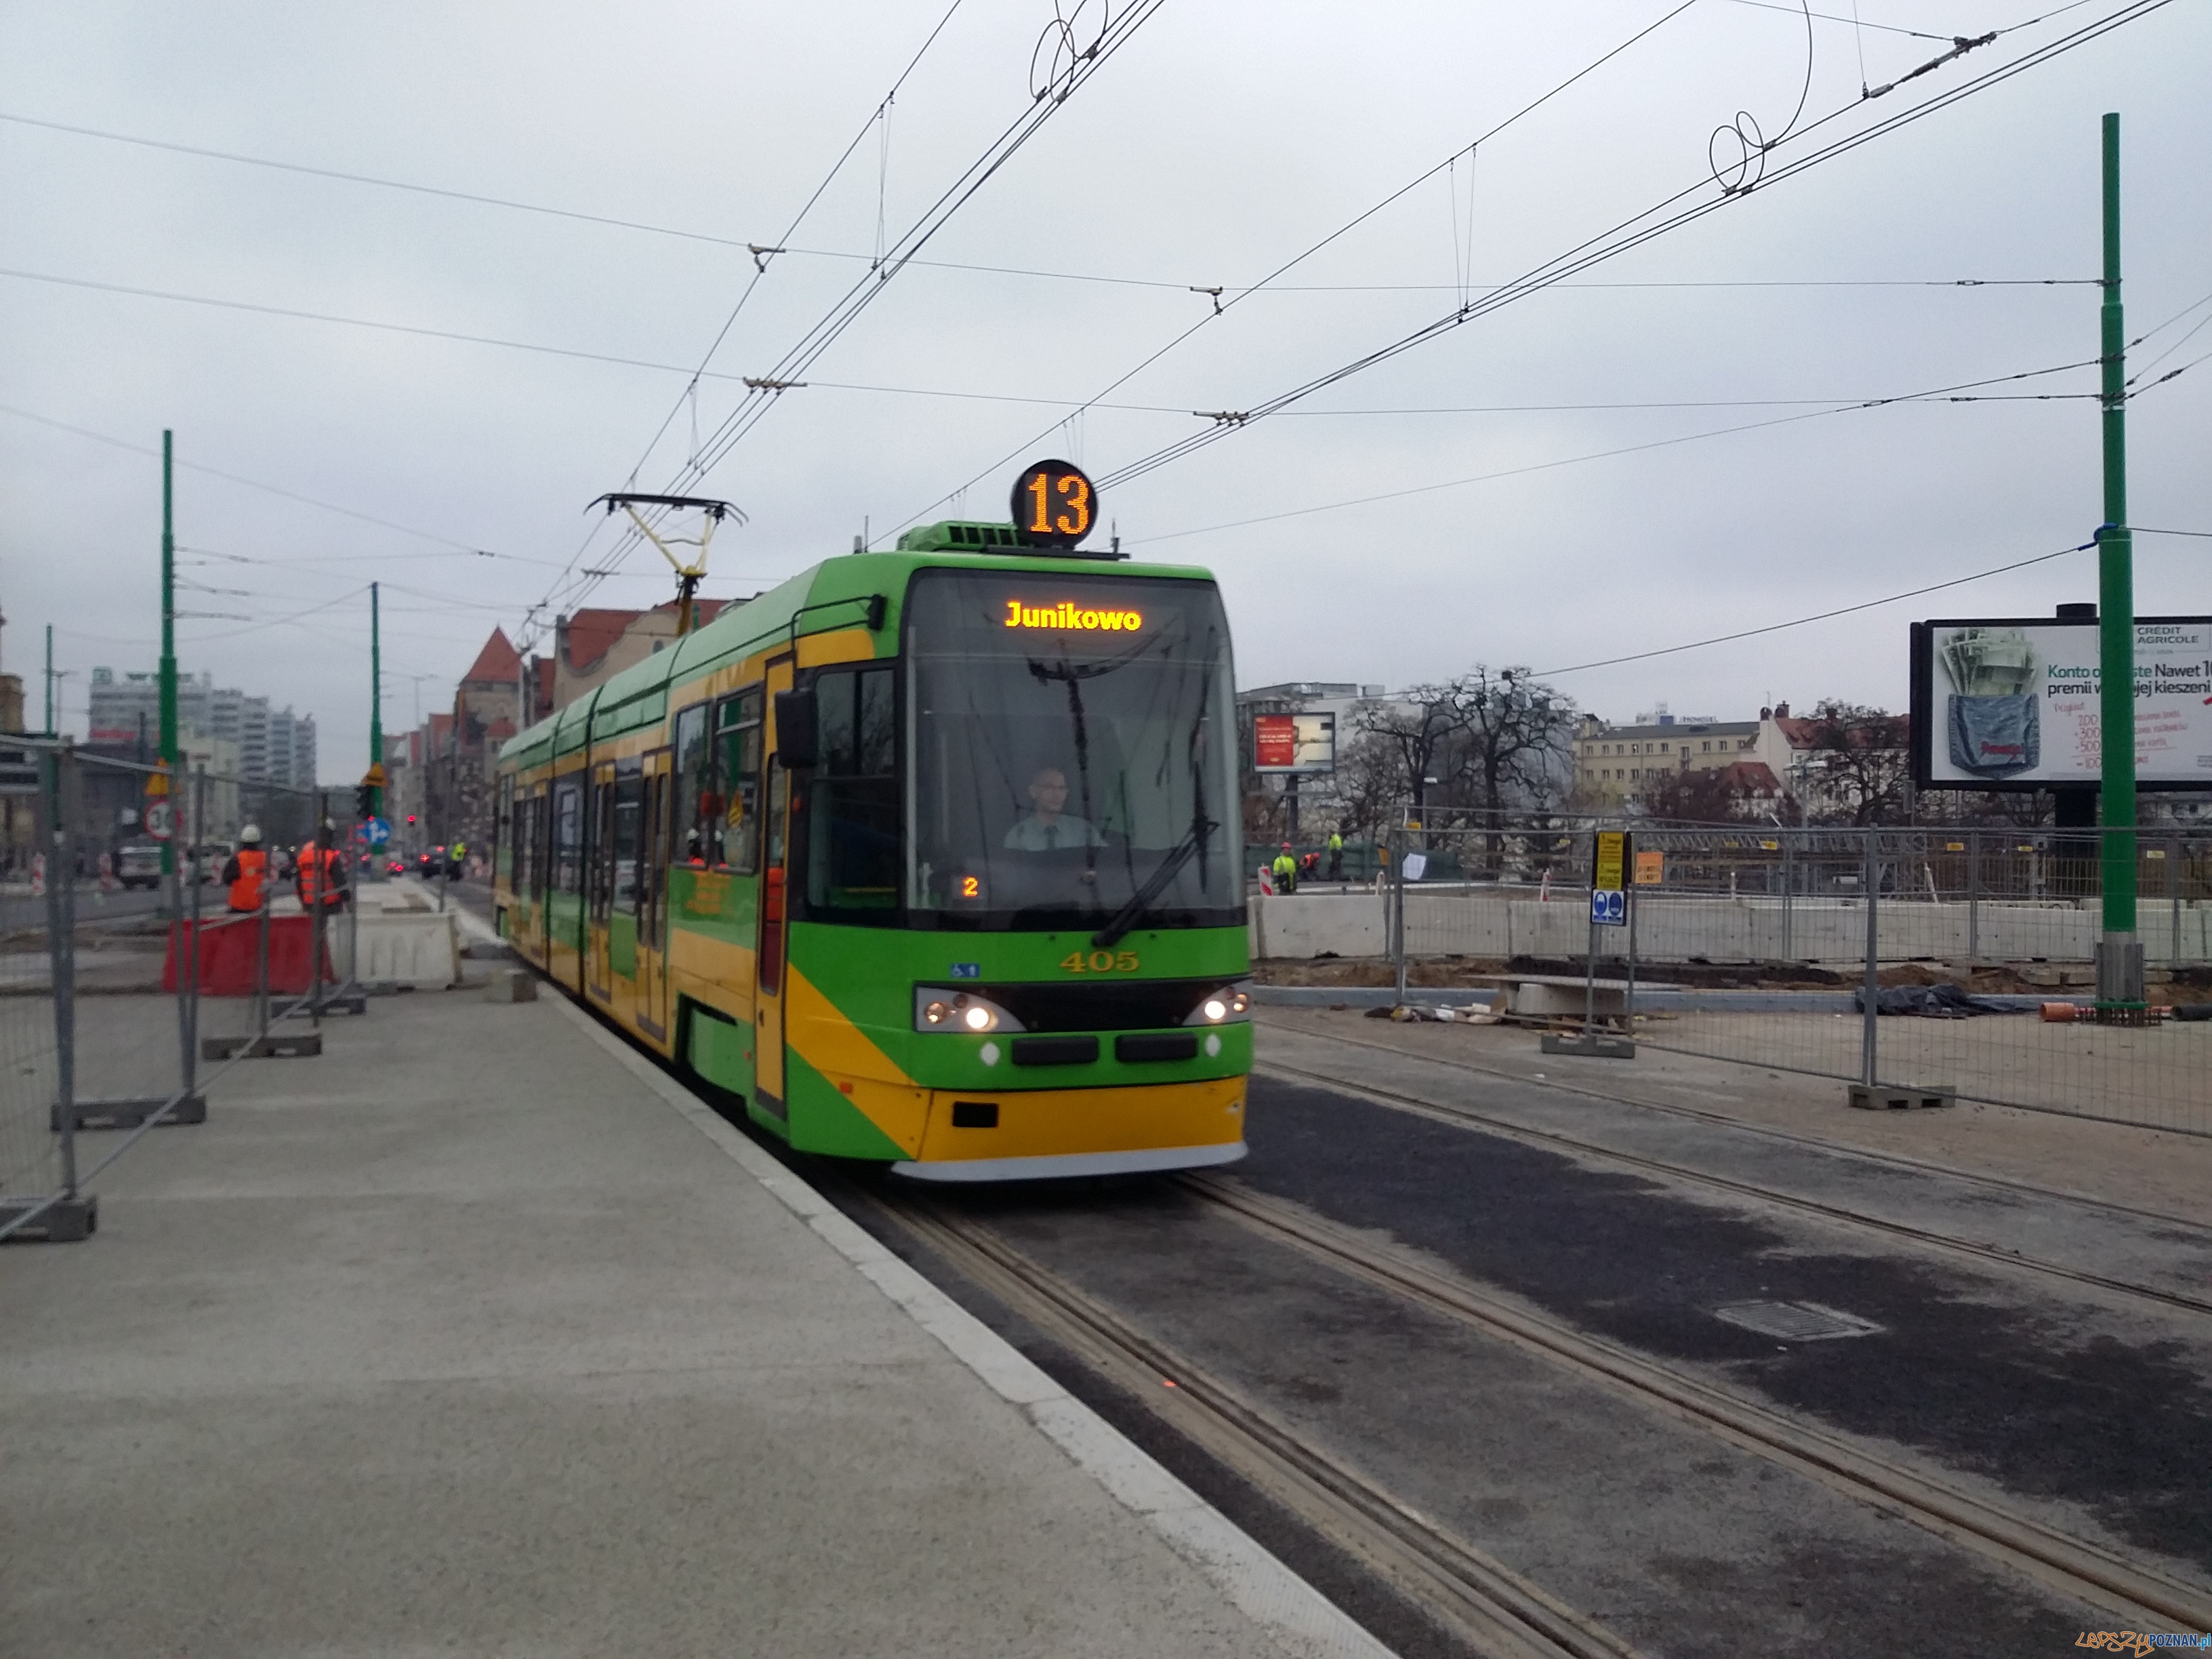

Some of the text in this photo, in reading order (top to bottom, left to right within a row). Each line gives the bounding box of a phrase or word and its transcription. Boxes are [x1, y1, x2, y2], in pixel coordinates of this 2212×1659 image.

[1028, 473, 1089, 535] 13
[1005, 600, 1143, 632] Junikowo
[2137, 635, 2199, 644] AGRICOLE
[2048, 664, 2090, 678] Konto
[2155, 663, 2201, 677] Nawet
[2048, 680, 2092, 698] premii
[2155, 679, 2211, 695] kieszeni
[2078, 714, 2098, 726] 200
[963, 877, 978, 897] 2
[1060, 951, 1140, 972] 405
